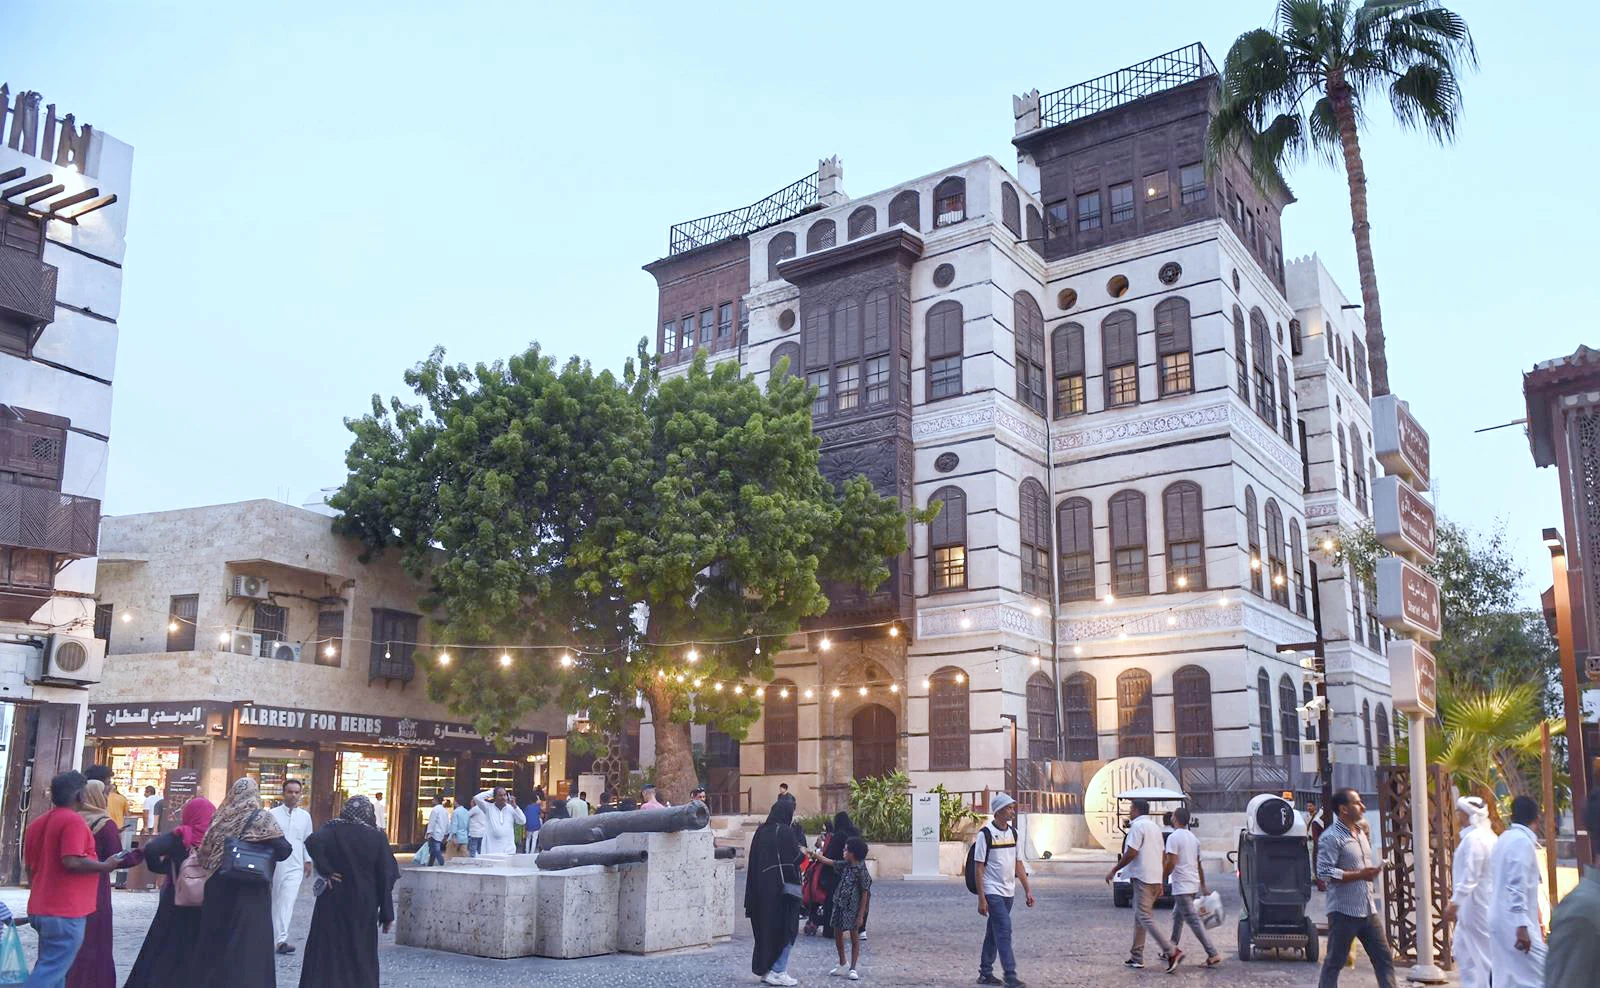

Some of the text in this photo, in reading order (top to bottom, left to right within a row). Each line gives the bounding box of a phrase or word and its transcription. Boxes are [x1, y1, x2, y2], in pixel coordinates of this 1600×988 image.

[105, 708, 149, 727] للعطارة
[150, 706, 201, 728] البريدي
[240, 707, 305, 728] ALBREDY
[310, 713, 336, 730] FOR
[341, 716, 382, 733] HERBS
